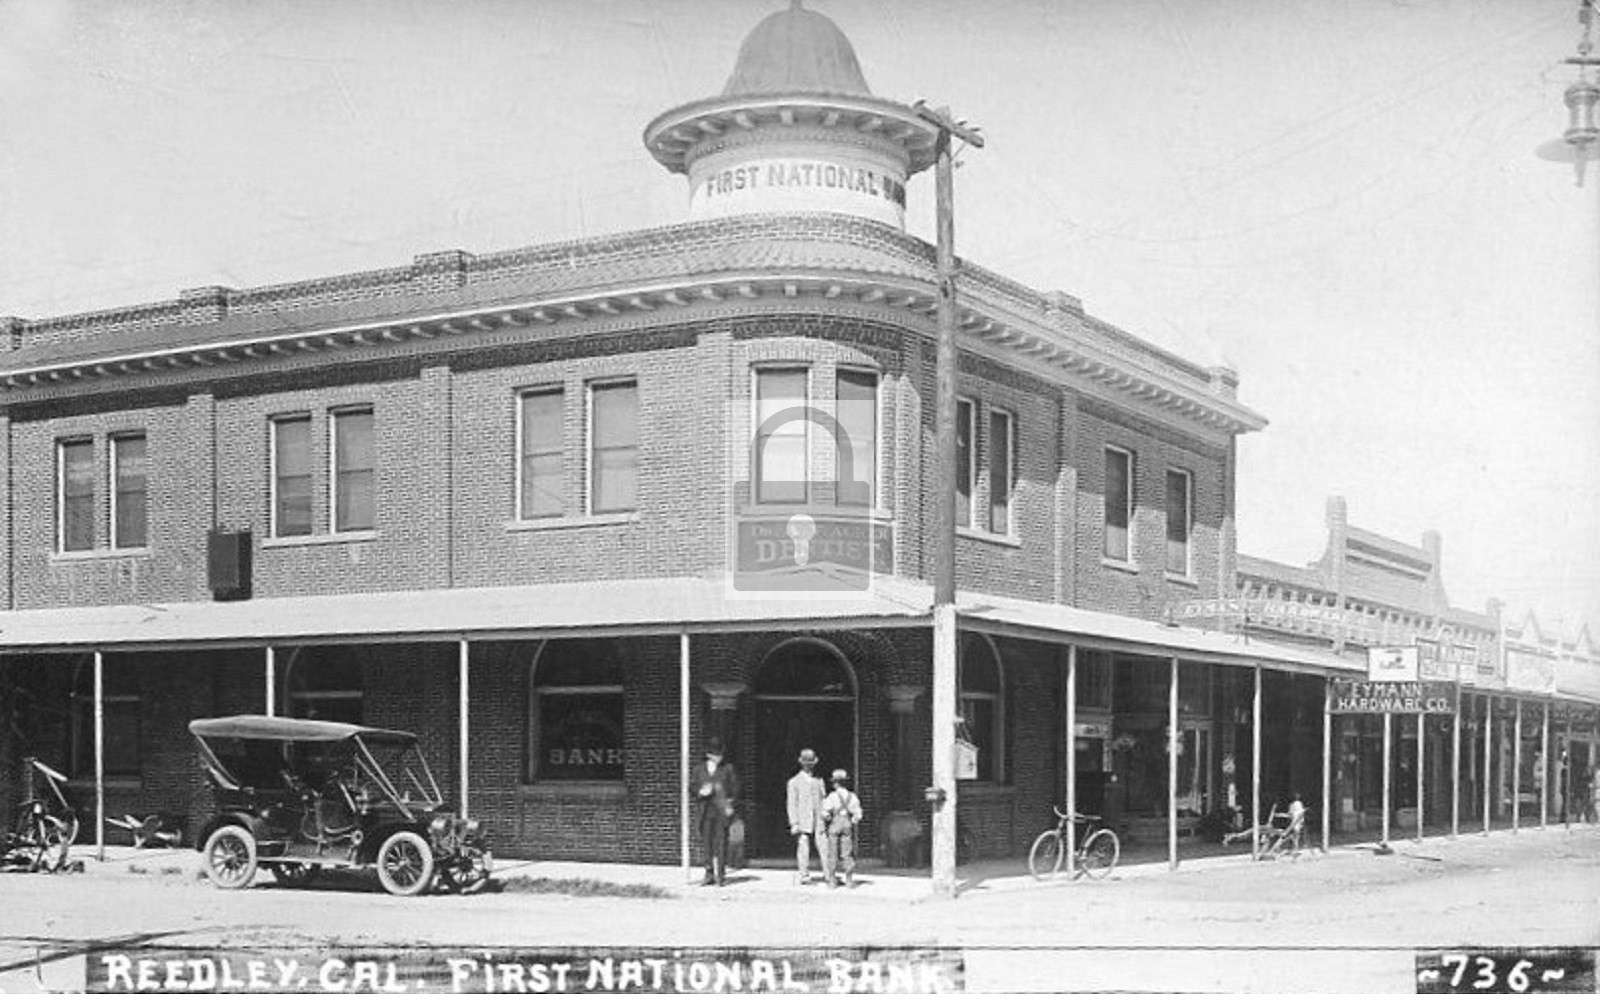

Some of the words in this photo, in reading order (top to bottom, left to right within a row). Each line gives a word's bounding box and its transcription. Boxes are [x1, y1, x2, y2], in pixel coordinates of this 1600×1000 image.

[707, 166, 760, 197] FIRST
[768, 164, 878, 196] NATIONAL
[1351, 682, 1422, 698] EYMANN
[1338, 698, 1423, 711] HARDWARE
[549, 749, 623, 764] BANK
